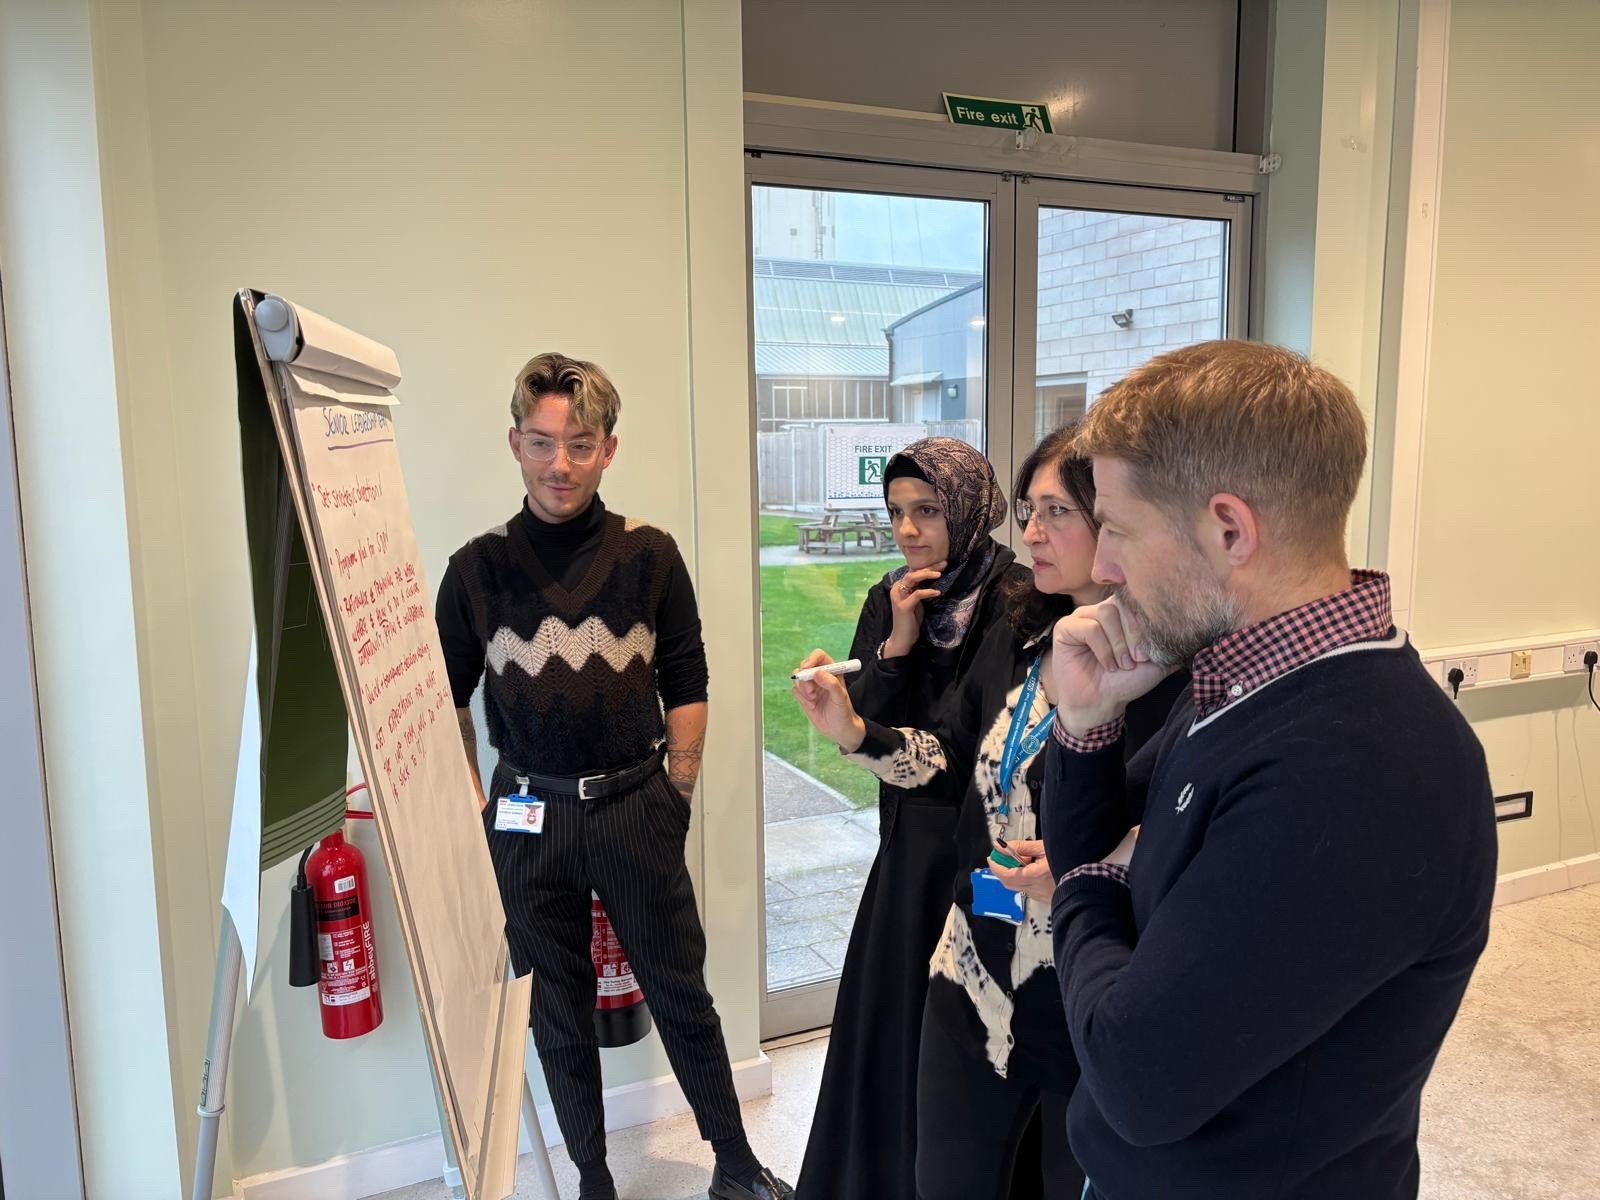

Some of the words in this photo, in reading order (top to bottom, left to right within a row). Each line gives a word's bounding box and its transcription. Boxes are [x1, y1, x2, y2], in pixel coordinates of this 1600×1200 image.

[956, 106, 985, 121] Fire
[990, 112, 1019, 125] exit
[854, 445, 872, 453] FIRE
[874, 445, 891, 453] EXIT
[363, 921, 376, 980] abbeyFIRE
